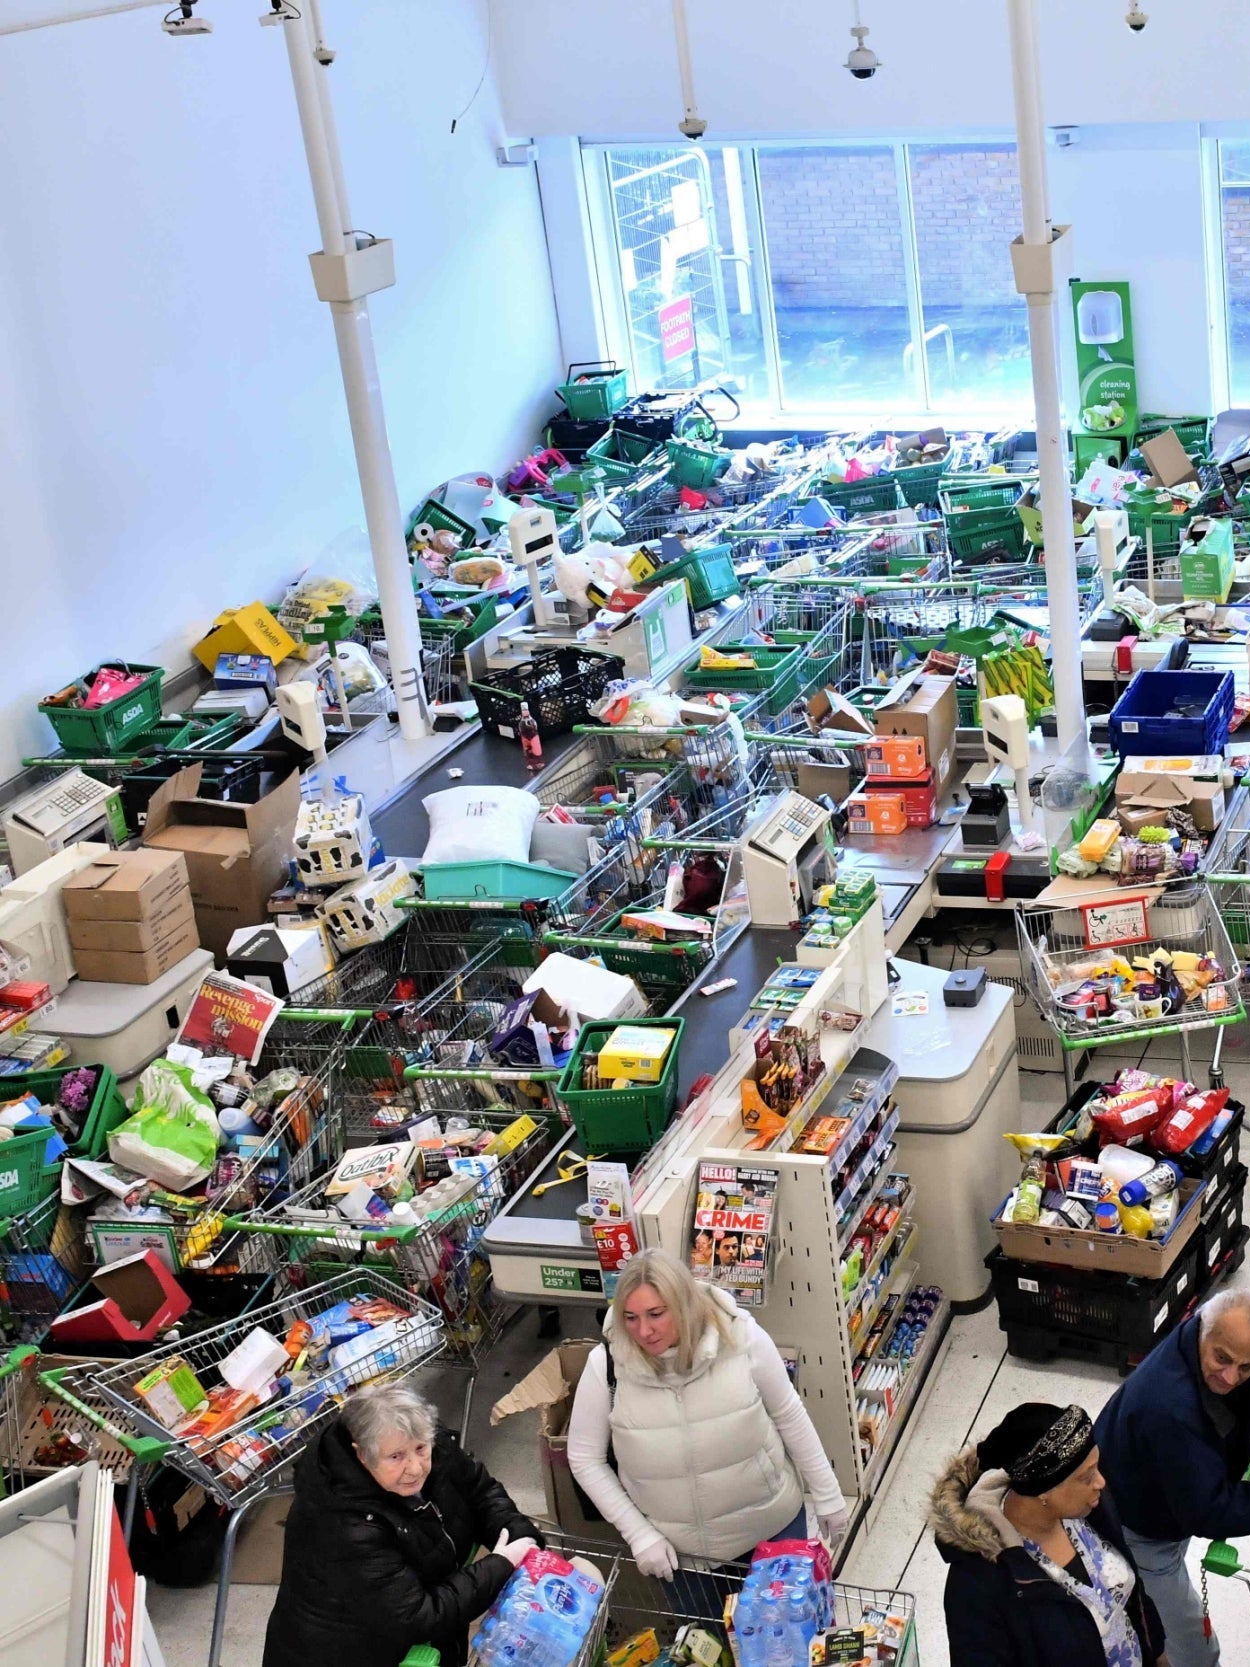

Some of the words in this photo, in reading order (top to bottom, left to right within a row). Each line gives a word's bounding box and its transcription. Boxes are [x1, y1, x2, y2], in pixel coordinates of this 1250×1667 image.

[661, 311, 691, 334] FOOTPATH
[665, 327, 690, 348] CLOSED
[1099, 379, 1130, 390] cleaning
[1100, 391, 1126, 399] station
[256, 618, 281, 648] HIPPEAS
[122, 703, 144, 725] ASDA
[200, 984, 256, 1014] Revenge
[254, 991, 277, 1007] Sport
[211, 1004, 265, 1032] mission
[341, 1151, 396, 1178] Oatibix
[701, 1166, 736, 1181] HELLO!
[696, 1209, 765, 1231] CRIME
[597, 1239, 615, 1249] £10
[543, 1267, 576, 1277] Under
[733, 1266, 746, 1275] LIFE
[544, 1277, 564, 1287] 25?
[739, 1274, 762, 1284] BUNDY
